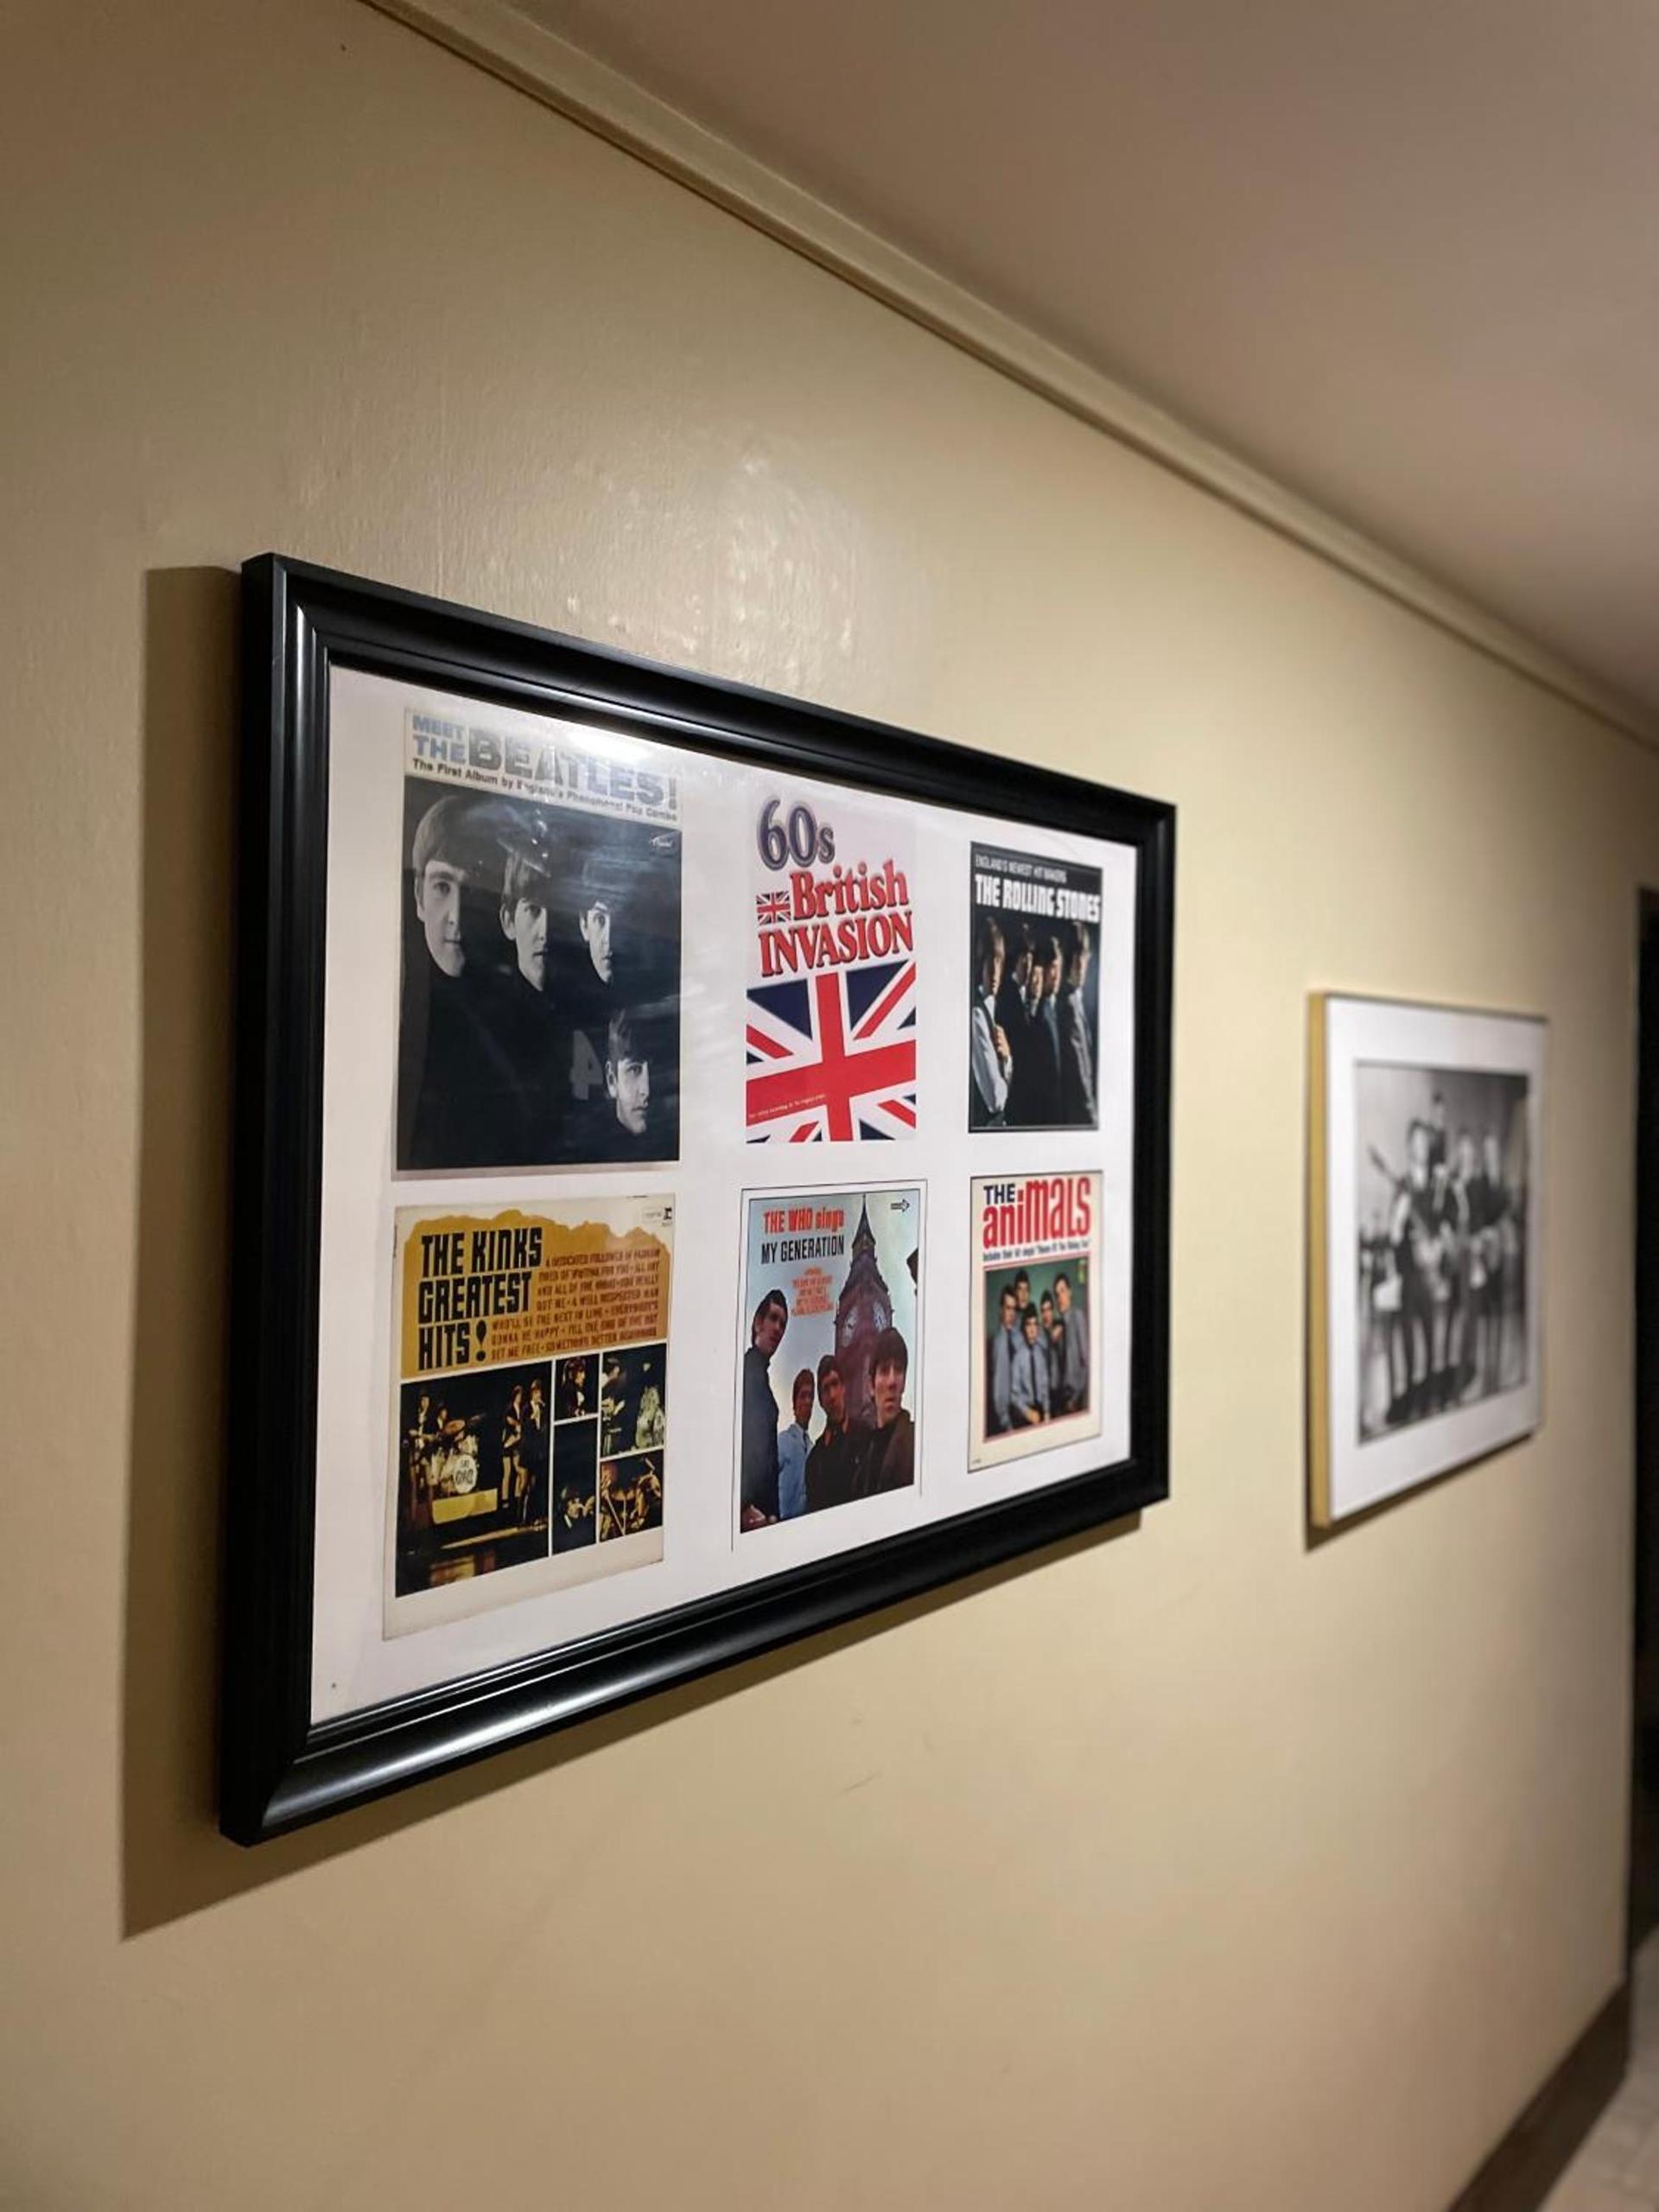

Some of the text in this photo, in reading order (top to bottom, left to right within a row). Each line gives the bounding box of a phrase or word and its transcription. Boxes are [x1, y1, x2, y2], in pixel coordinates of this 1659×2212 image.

[412, 728, 677, 810] THE BEATLES!
[413, 758, 433, 771] The
[437, 762, 461, 777] First
[466, 768, 498, 785] Album
[501, 776, 513, 790] by
[756, 797, 836, 870] 60s
[790, 858, 909, 922] British
[975, 874, 1101, 924] THE ROLLING STONES
[758, 911, 913, 977] INVASION
[763, 1206, 844, 1234] THE WHO sings
[983, 1183, 1015, 1205] THE
[421, 1227, 542, 1279] THE KINKS
[760, 1235, 844, 1264] MY GENERATION
[418, 1270, 531, 1324] GREATEST
